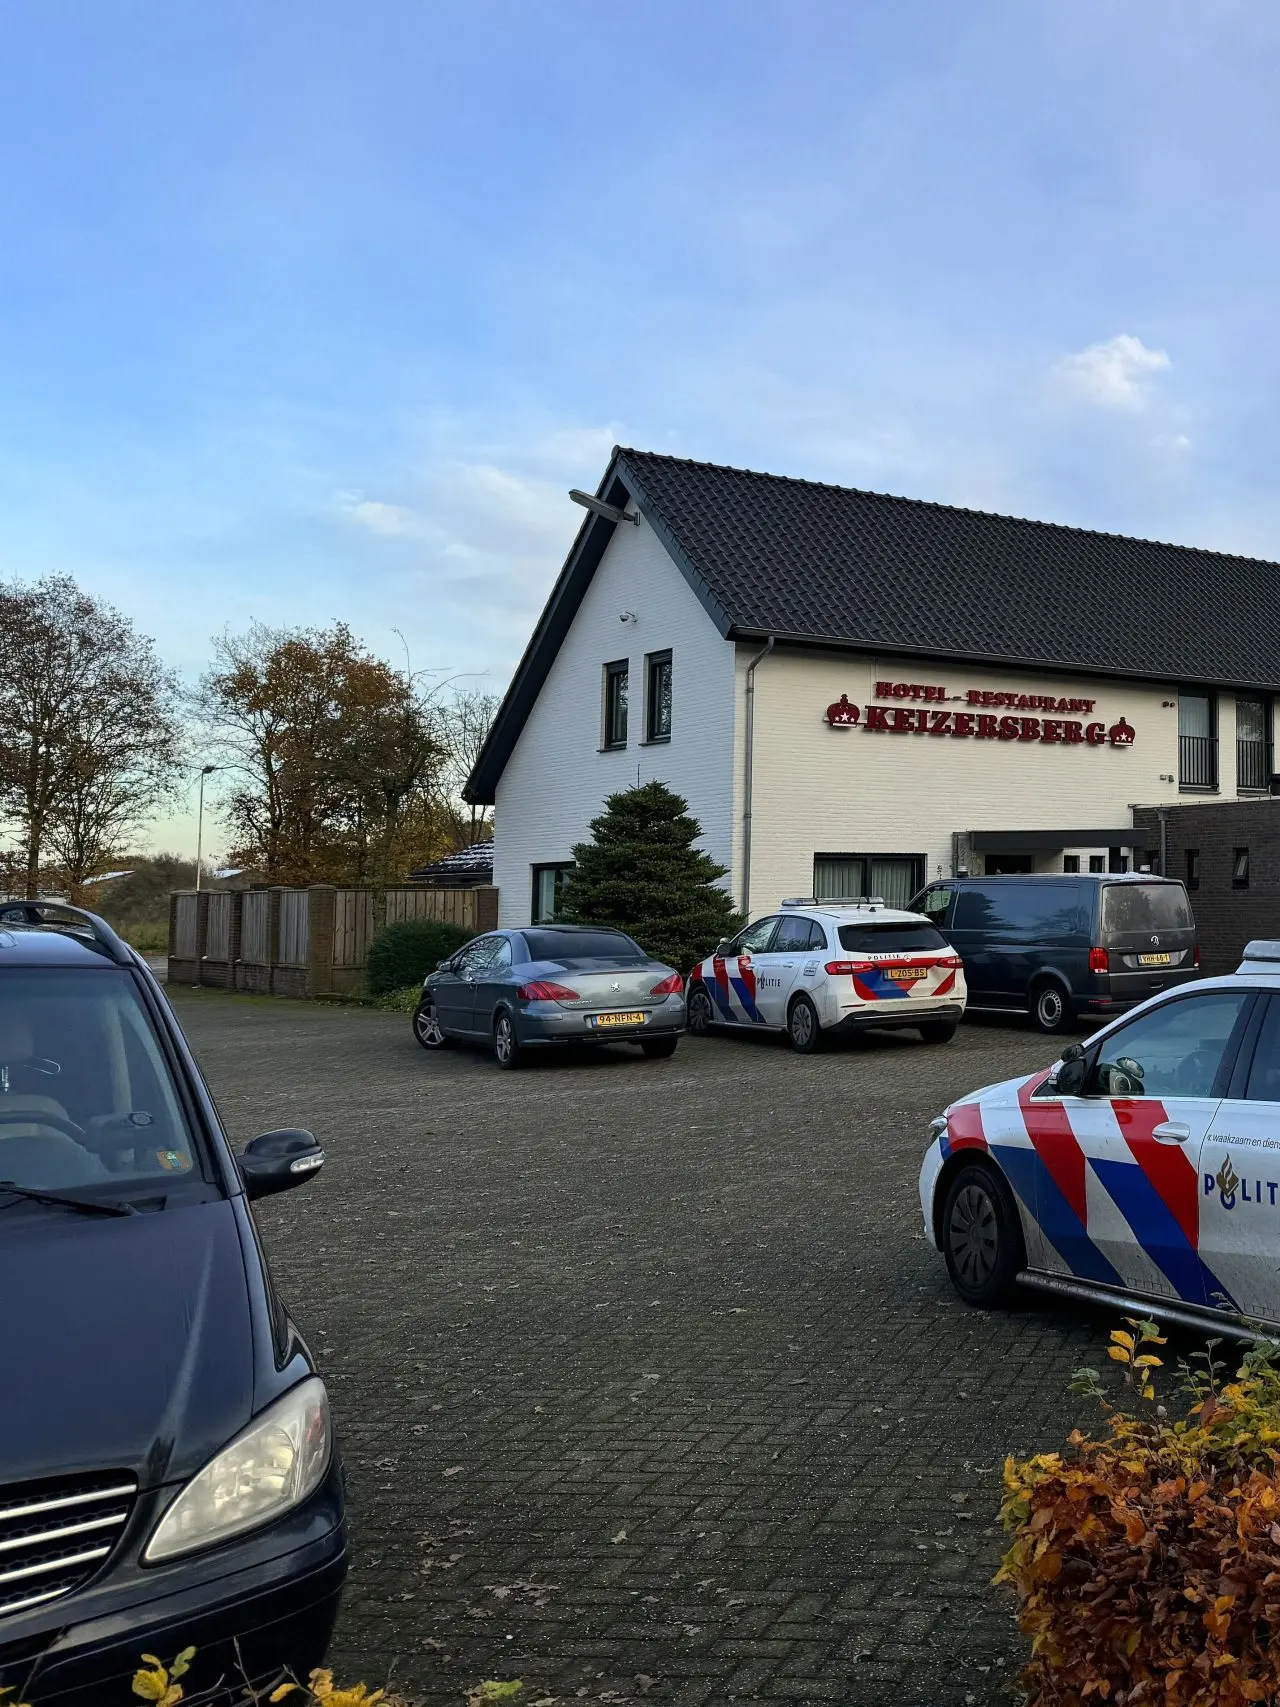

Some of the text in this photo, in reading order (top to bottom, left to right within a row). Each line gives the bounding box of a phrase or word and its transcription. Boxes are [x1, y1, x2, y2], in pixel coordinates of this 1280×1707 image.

[874, 681, 949, 702] HOTEL
[966, 690, 1096, 713] RESTAURANT
[864, 705, 1106, 744] KEIZERSBERG
[890, 968, 925, 977] L-205-BS
[599, 1013, 641, 1023] 94-NFN-4
[1213, 1133, 1252, 1146] waakzaam
[1252, 1139, 1262, 1148] en
